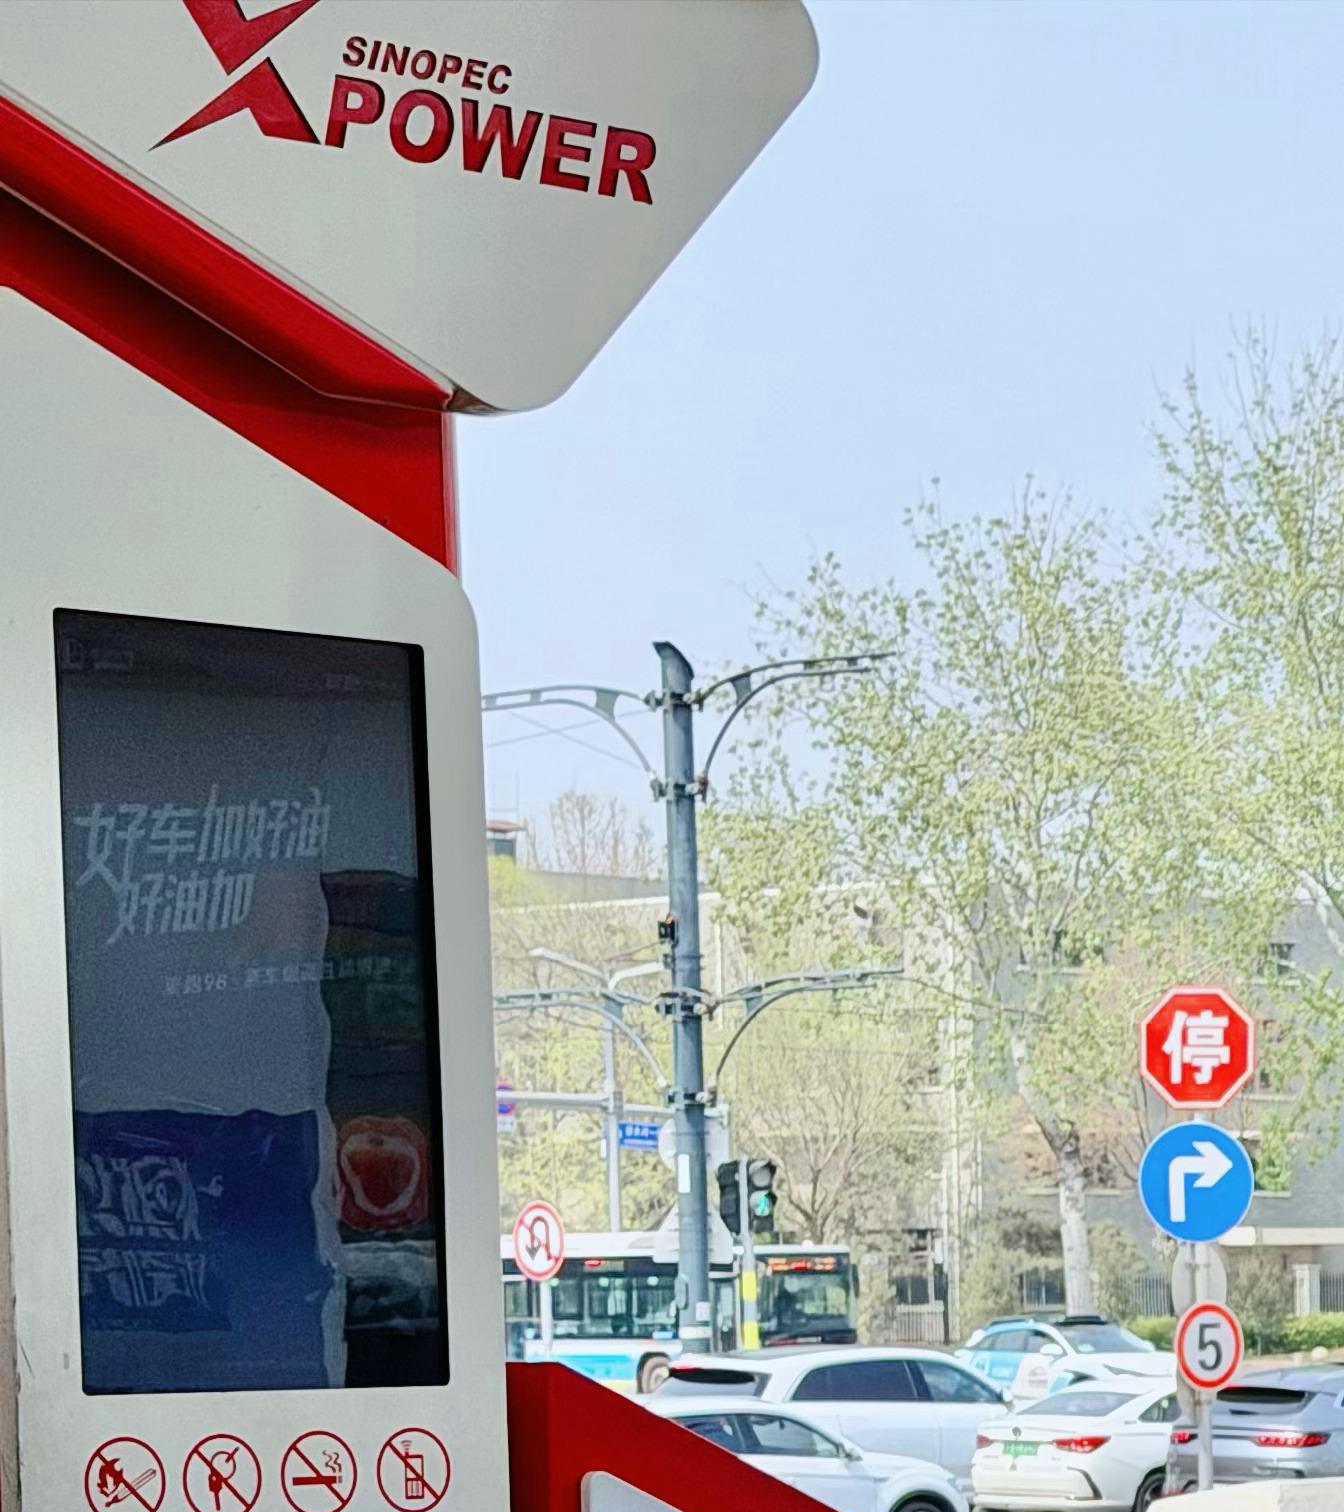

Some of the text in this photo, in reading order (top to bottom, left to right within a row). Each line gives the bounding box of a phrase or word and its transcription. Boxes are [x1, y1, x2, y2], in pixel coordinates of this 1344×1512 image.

[342, 36, 512, 94] SINOPEC
[325, 74, 656, 205] POWER
[1162, 1009, 1230, 1085] 停
[1197, 1322, 1223, 1372] 5
